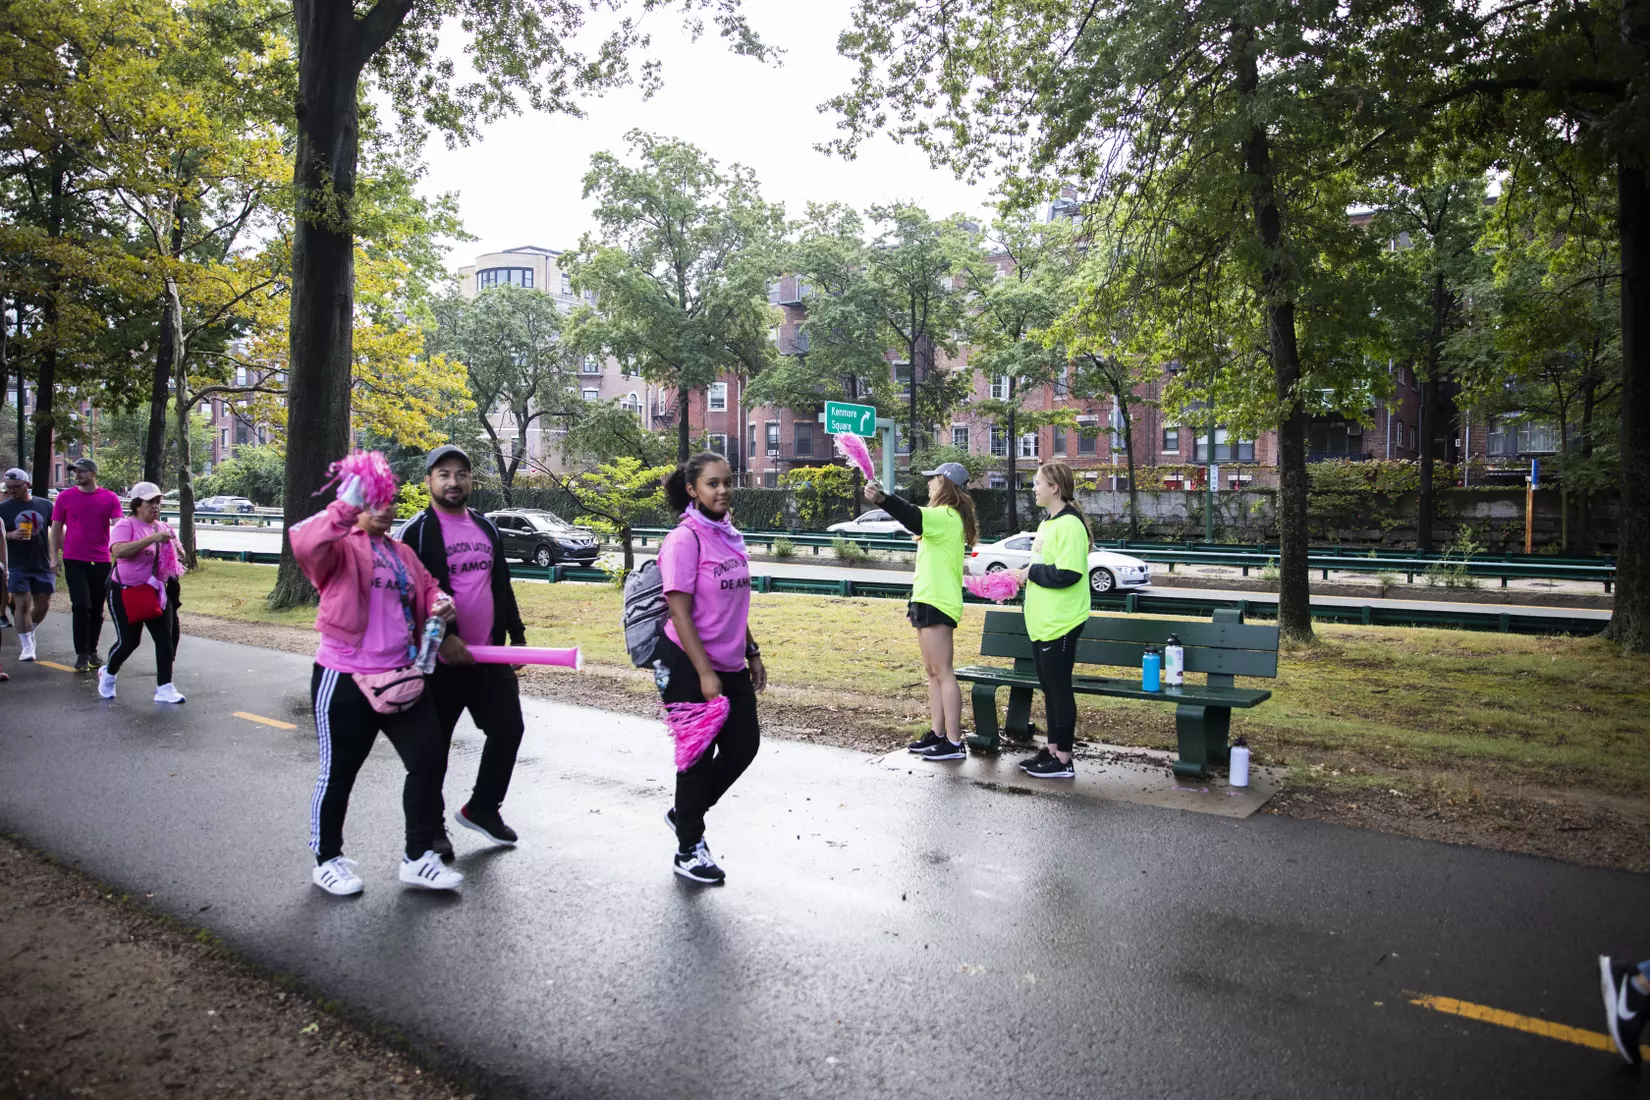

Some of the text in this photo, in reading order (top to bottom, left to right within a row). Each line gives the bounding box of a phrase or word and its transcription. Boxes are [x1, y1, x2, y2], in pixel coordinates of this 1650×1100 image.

[831, 406, 857, 418] Kenmore
[831, 420, 852, 432] Square
[720, 579, 734, 590] DE
